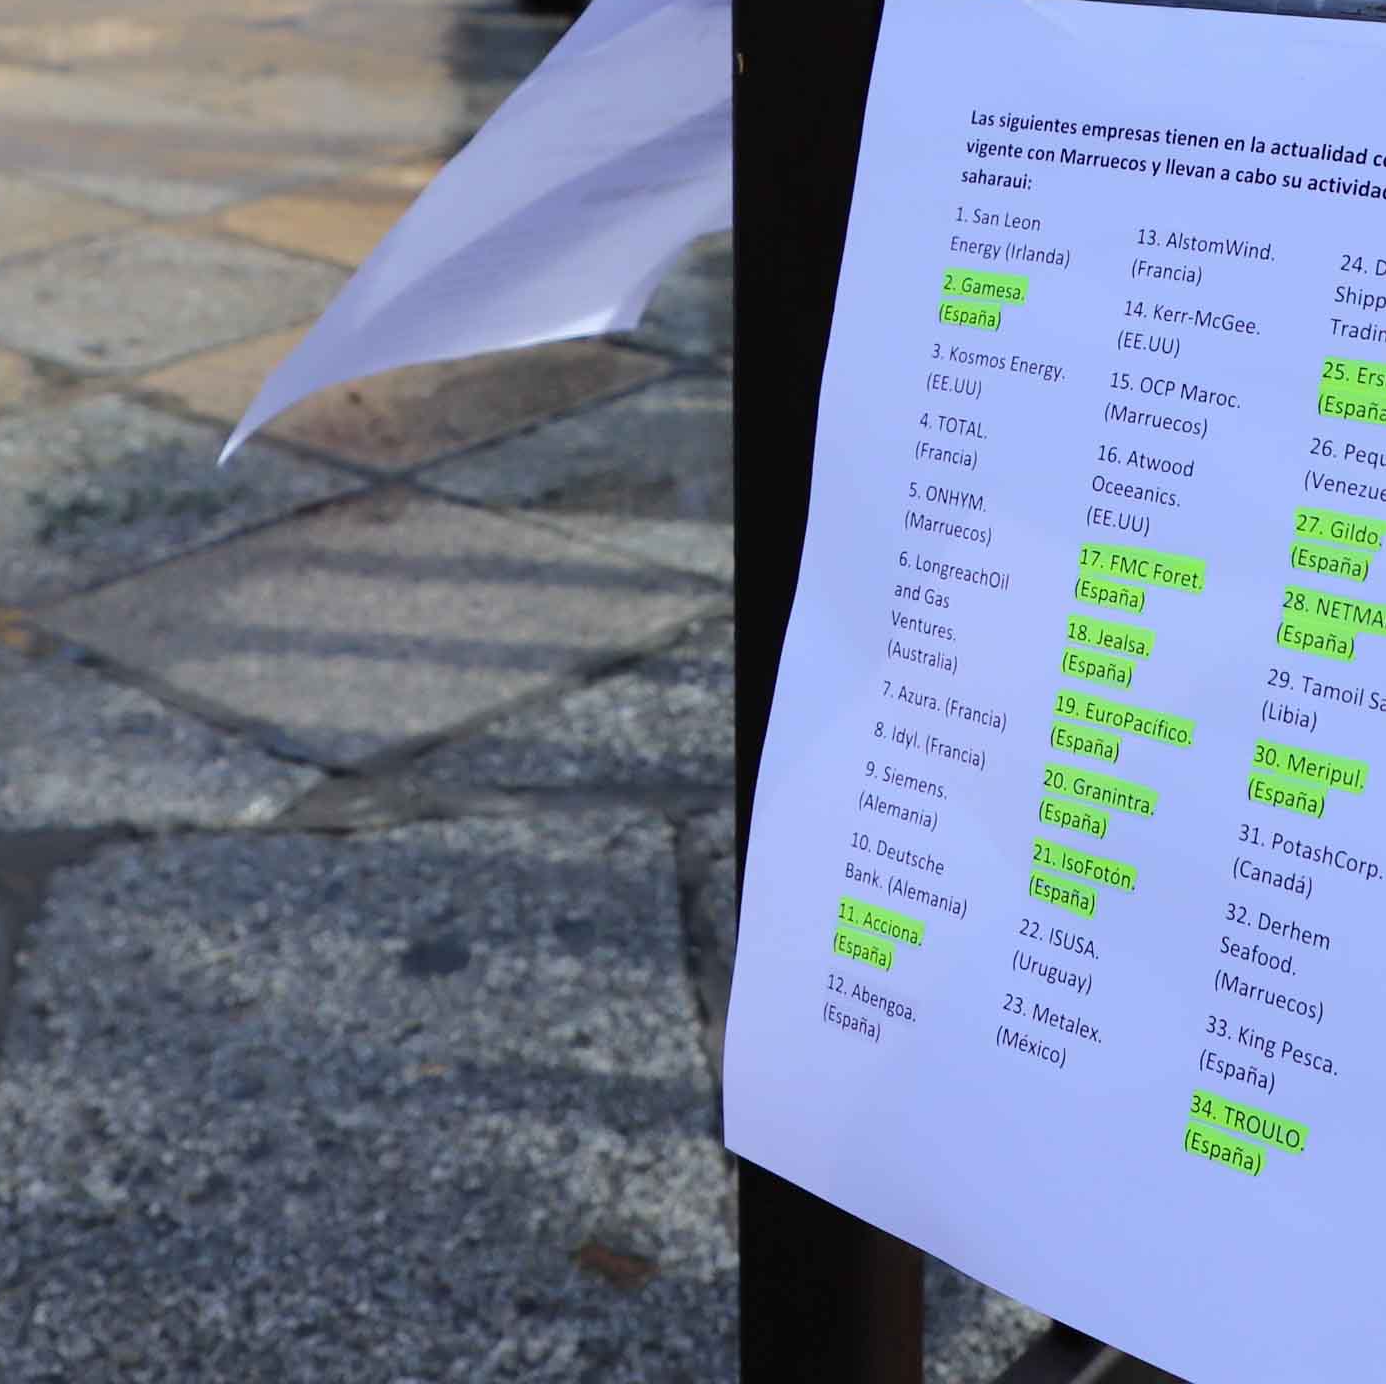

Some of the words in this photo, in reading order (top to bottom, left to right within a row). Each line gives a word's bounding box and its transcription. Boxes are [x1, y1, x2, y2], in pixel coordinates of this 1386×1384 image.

[970, 109, 996, 127] Las
[998, 112, 1078, 135] siguientes
[1081, 123, 1161, 144] empresas
[1164, 128, 1219, 150] tienen
[1223, 137, 1246, 153] en
[1249, 135, 1266, 154] la
[1269, 141, 1369, 165] actualidad
[960, 167, 1033, 191] saharaui:
[966, 138, 1024, 159] vigente
[1026, 147, 1055, 163] con
[1059, 147, 1147, 173] Marruecos
[1151, 160, 1162, 177] y
[1165, 157, 1216, 180] llevan
[1219, 168, 1231, 182] a
[1235, 167, 1278, 187] cabo
[1281, 174, 1303, 190] su
[956, 206, 968, 223] 1.
[972, 207, 1000, 227] San
[1004, 211, 1041, 232] Leon
[949, 235, 1002, 261] Energy
[1005, 241, 1070, 270] (Irlanda)
[1136, 228, 1161, 247] 13.
[1165, 231, 1275, 262] AlstomWind.
[1340, 254, 1368, 275] 24.
[943, 274, 957, 291] 2.
[961, 276, 1025, 301] Gamesa.
[1131, 257, 1203, 288] (Francia)
[938, 303, 1002, 332] (España)
[1124, 300, 1148, 319] 14.
[1153, 303, 1261, 336] Kerr-McGee.
[932, 343, 944, 360] 3.
[949, 345, 1006, 370] Kosmos
[1009, 355, 1066, 383] Energy.
[1117, 329, 1180, 359] (EE.UU)
[926, 372, 982, 401] (EE.UU)
[1109, 371, 1134, 391] 15.
[1140, 376, 1176, 397] OCP
[1180, 383, 1241, 409] Maroc.
[1321, 361, 1350, 382] 25.
[919, 412, 932, 429] 4.
[937, 415, 988, 440] TOTAL.
[1104, 401, 1208, 441] (Marruecos)
[915, 440, 978, 472] (Francia)
[1097, 444, 1122, 465] 16.
[1125, 450, 1195, 478] Atwood
[1309, 437, 1337, 459] 26.
[908, 481, 921, 500] 5.
[925, 485, 989, 513] ONHYM.
[1092, 474, 1181, 508] Oceeanics.
[904, 509, 992, 548] (Marruecos)
[1086, 505, 1150, 538] (EE.UU)
[1295, 513, 1323, 535] 27.
[1330, 520, 1383, 547] Gildo.
[898, 550, 911, 569] 6.
[915, 553, 1010, 591] LongreachOil
[1079, 548, 1104, 569] 17.
[1109, 554, 1150, 578] FMC
[1152, 562, 1204, 590] Foret.
[1291, 545, 1369, 583] (España)
[894, 584, 922, 601] and
[924, 588, 950, 609] Gas
[1074, 577, 1146, 613] (España)
[1282, 590, 1309, 613] 28.
[891, 609, 958, 641] Ventures.
[1067, 622, 1091, 643] 18.
[1095, 628, 1149, 657] Jealsa.
[1276, 622, 1355, 659] (España)
[887, 639, 958, 676] (Australia)
[1062, 651, 1133, 689] (España)
[882, 679, 894, 699] 7.
[897, 685, 941, 712] Azura.
[945, 696, 1007, 734] (Francia)
[1055, 695, 1080, 717] 19.
[1266, 668, 1294, 691] 29.
[1301, 675, 1365, 707] Tamoil
[1261, 699, 1318, 734] (Libia)
[873, 721, 887, 739] 8.
[891, 725, 921, 750] Idyl.
[925, 735, 986, 772] (Francia)
[1050, 726, 1120, 766] (España)
[865, 760, 878, 779] 9.
[881, 765, 947, 801] Siemens.
[1253, 744, 1280, 768] 30.
[1286, 753, 1364, 789] Meripul.
[858, 791, 938, 833] (Alemania)
[1042, 768, 1067, 792] 20.
[1073, 777, 1154, 816] Granintra.
[1247, 778, 1325, 819] (España)
[1038, 800, 1109, 843] (España)
[850, 831, 873, 853] 10.
[876, 839, 945, 876] Deutsche
[1032, 843, 1056, 867] 21.
[1061, 852, 1136, 891] IsoFotón.
[1238, 823, 1265, 848] 31.
[1270, 831, 1383, 881] PotashCorp.
[844, 861, 885, 889] Bank.
[887, 875, 968, 921] (Alemania)
[1029, 874, 1095, 916] (España)
[1232, 856, 1313, 901] (Canadá)
[838, 903, 859, 924] 11.
[862, 911, 922, 947] Acciona.
[1018, 918, 1043, 941] 22.
[1048, 927, 1099, 960] ISUSA.
[1225, 902, 1252, 927] 32.
[1257, 911, 1331, 951] Derhem
[833, 932, 892, 972] (España)
[1219, 935, 1297, 977] Seafood.
[1012, 949, 1092, 996] (Uruguay)
[827, 973, 848, 996] 12.
[850, 983, 916, 1023] Abengoa.
[1214, 968, 1324, 1025] (Marruecos)
[823, 1001, 881, 1044] (España)
[1002, 992, 1027, 1017] 23.
[1032, 1003, 1102, 1044] Metalex.
[996, 1024, 1067, 1070] (México)
[1205, 1015, 1232, 1041] 33.
[1237, 1025, 1277, 1059] King
[1280, 1040, 1338, 1077] Pesca.
[1199, 1048, 1275, 1096] (España)
[1190, 1095, 1217, 1121] 34.
[1224, 1105, 1305, 1152] TROULO.
[1184, 1128, 1261, 1177] (España)
